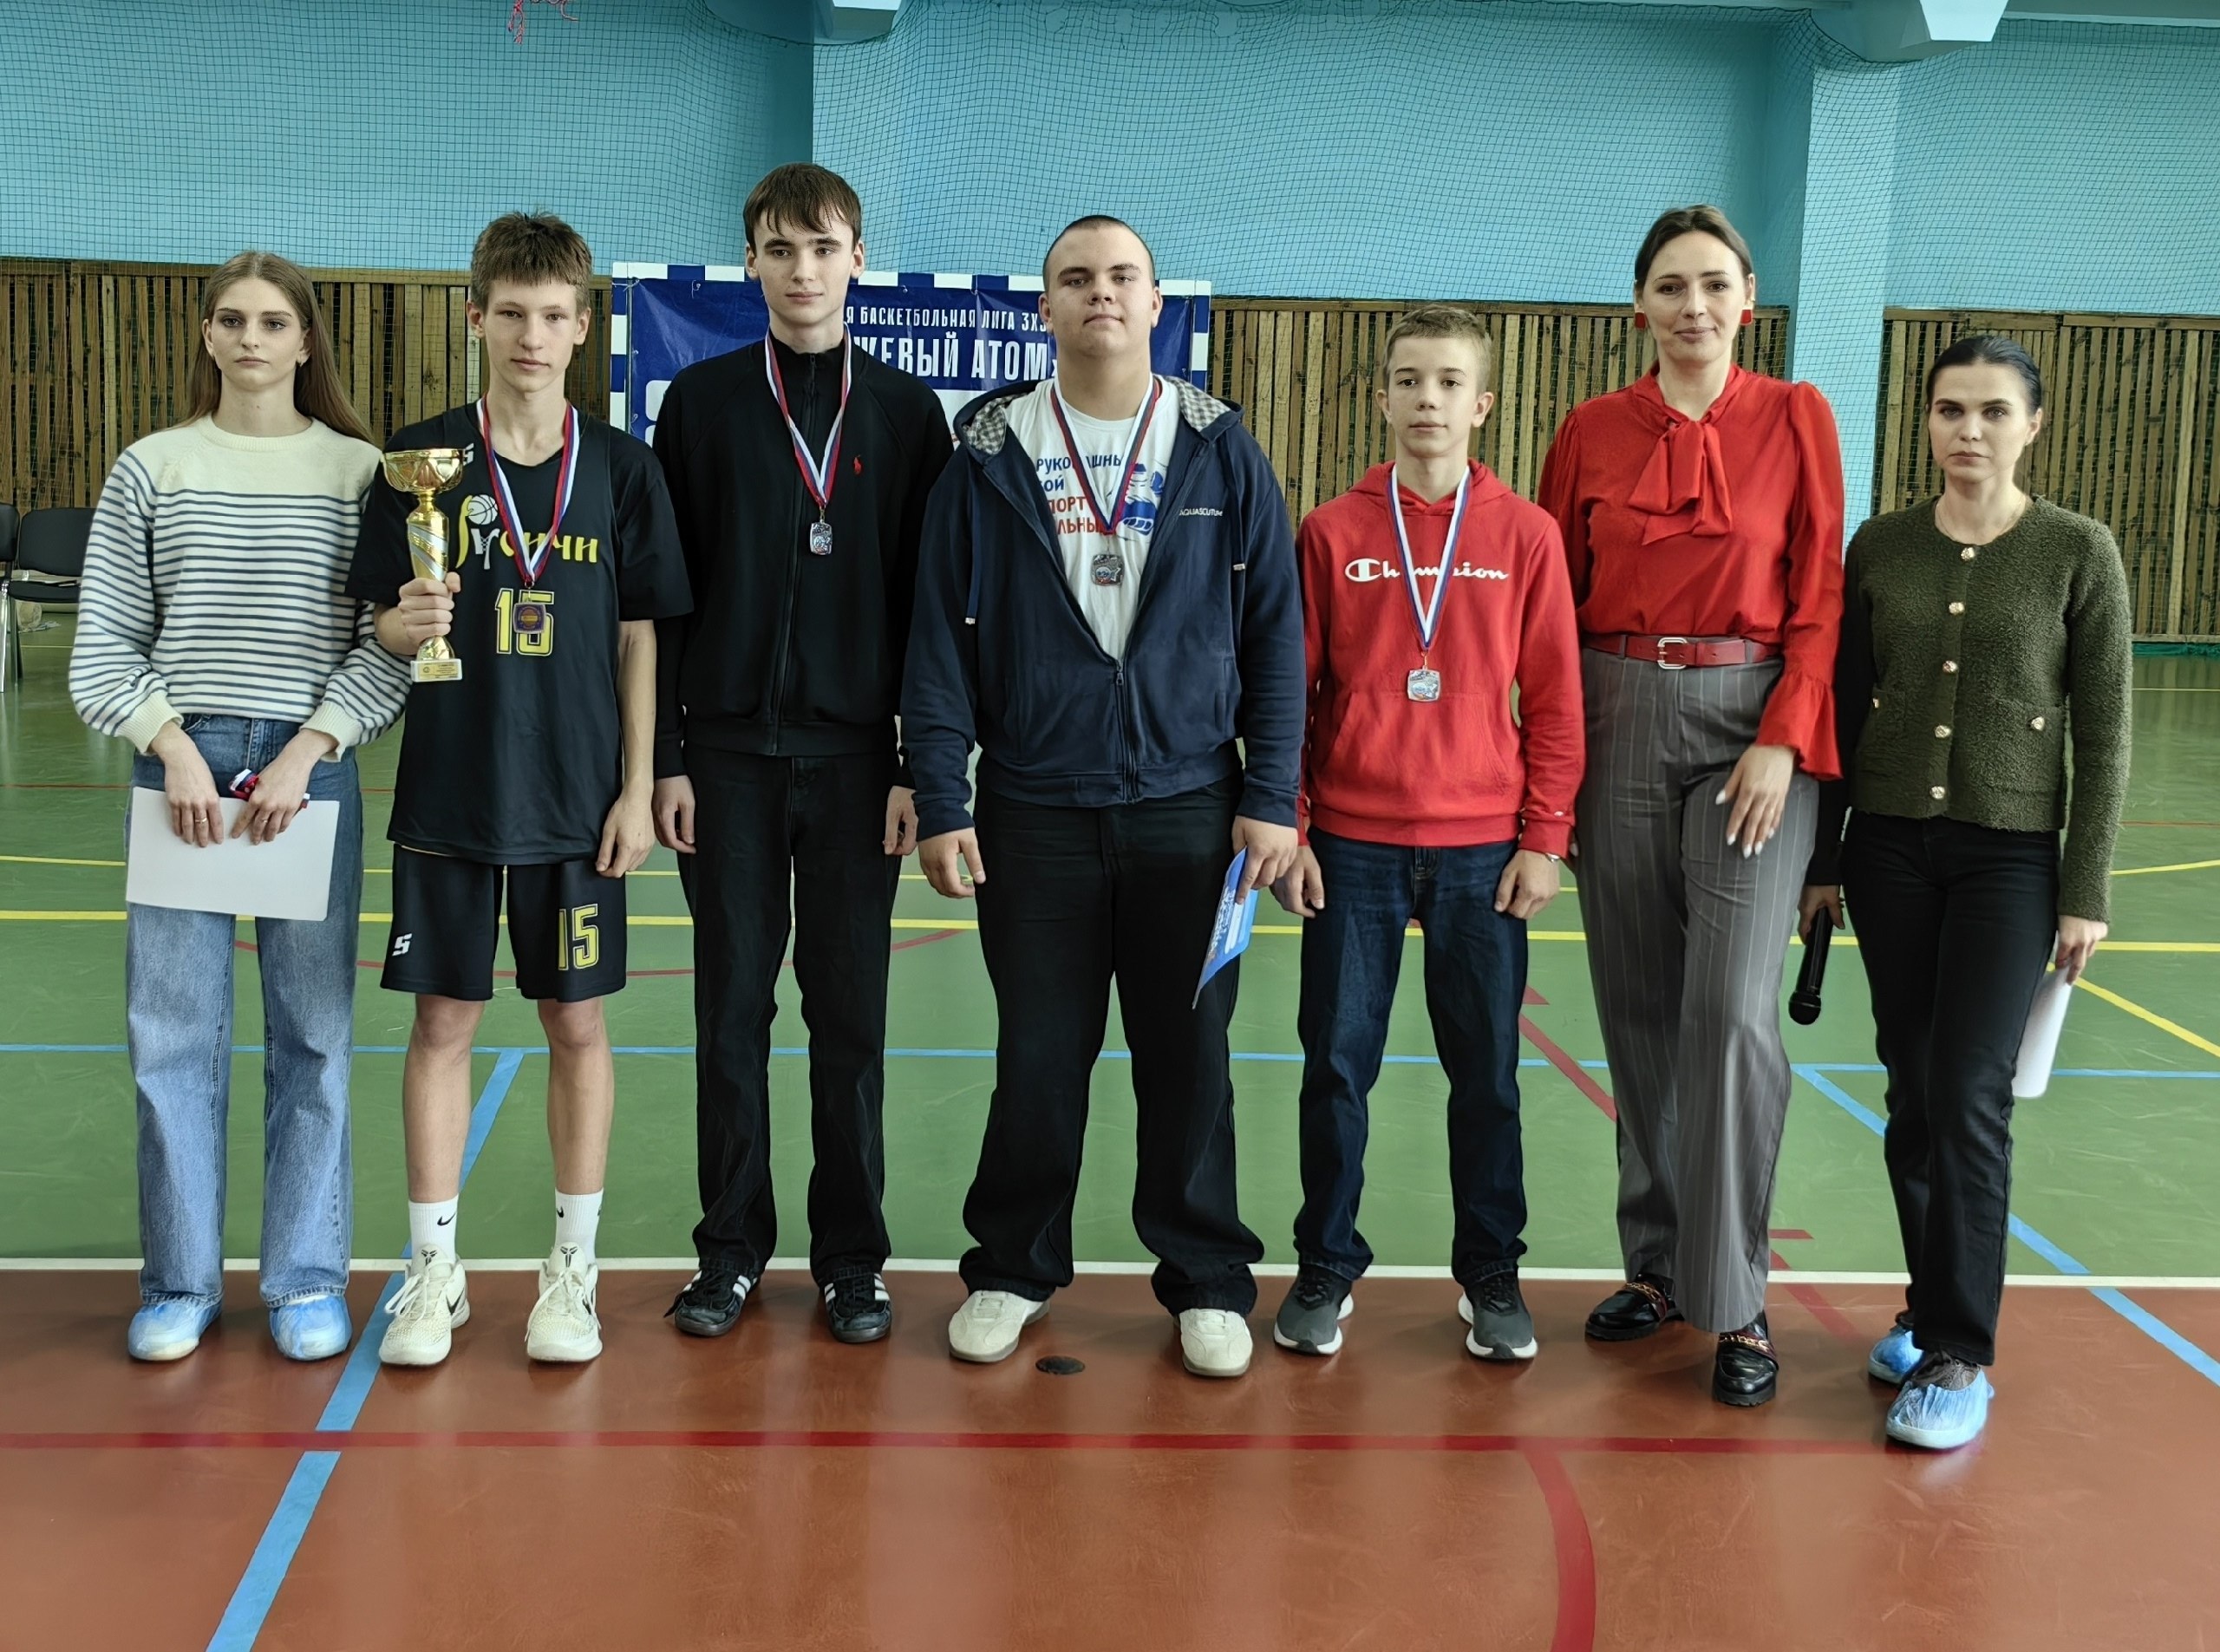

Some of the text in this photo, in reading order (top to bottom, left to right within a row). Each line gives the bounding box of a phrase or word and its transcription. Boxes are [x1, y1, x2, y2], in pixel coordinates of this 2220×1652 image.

[860, 306, 976, 328] БАСКЕТБОЛЬНАЯ
[981, 310, 1015, 330] ЛИГА
[1041, 474, 1065, 493] ОЙ
[1048, 496, 1087, 515] ПОРТ
[558, 903, 599, 971] 15
